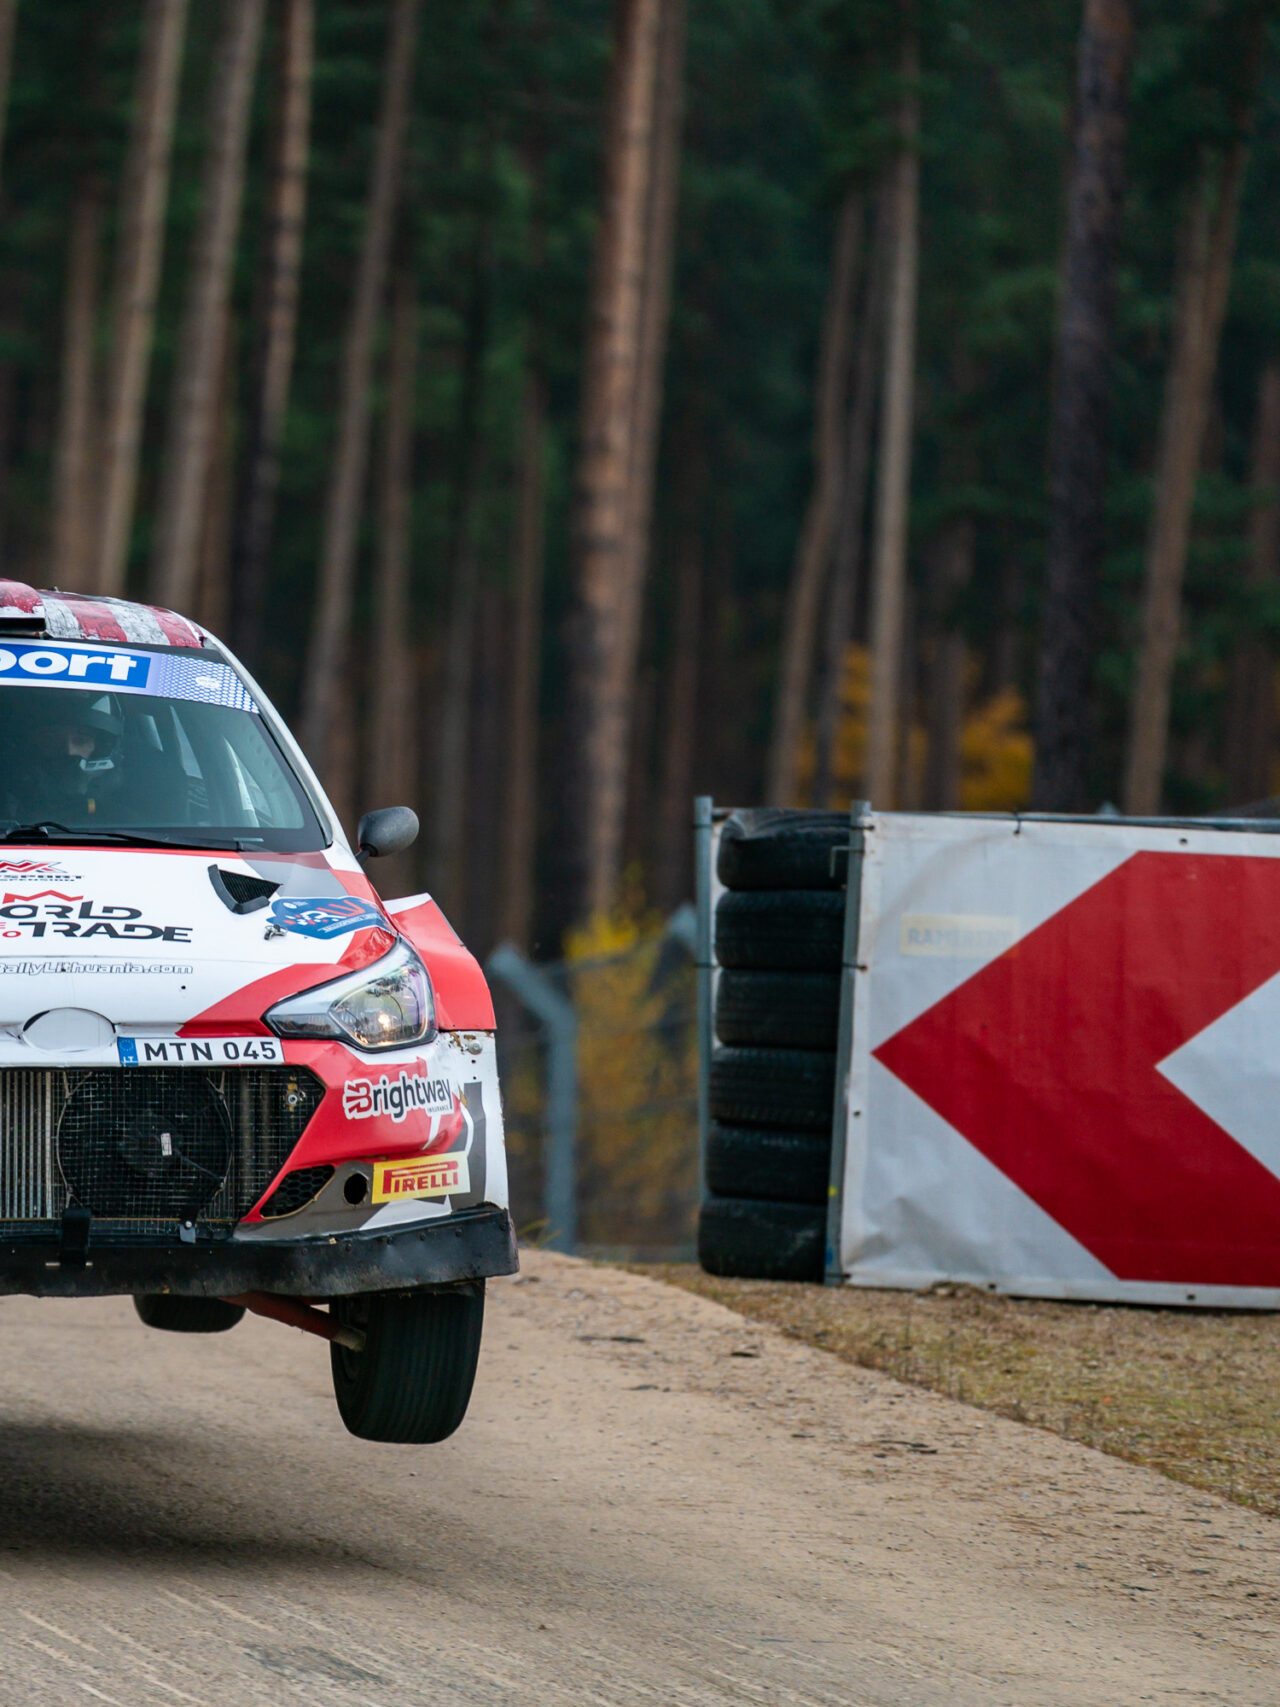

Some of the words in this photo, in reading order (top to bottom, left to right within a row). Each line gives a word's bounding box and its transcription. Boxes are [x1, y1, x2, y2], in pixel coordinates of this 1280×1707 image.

[18, 922, 193, 943] TRADE
[143, 1042, 213, 1061] MTN
[222, 1041, 277, 1060] 045
[345, 1075, 454, 1119] Brightway
[382, 1160, 459, 1195] PIRELLI
